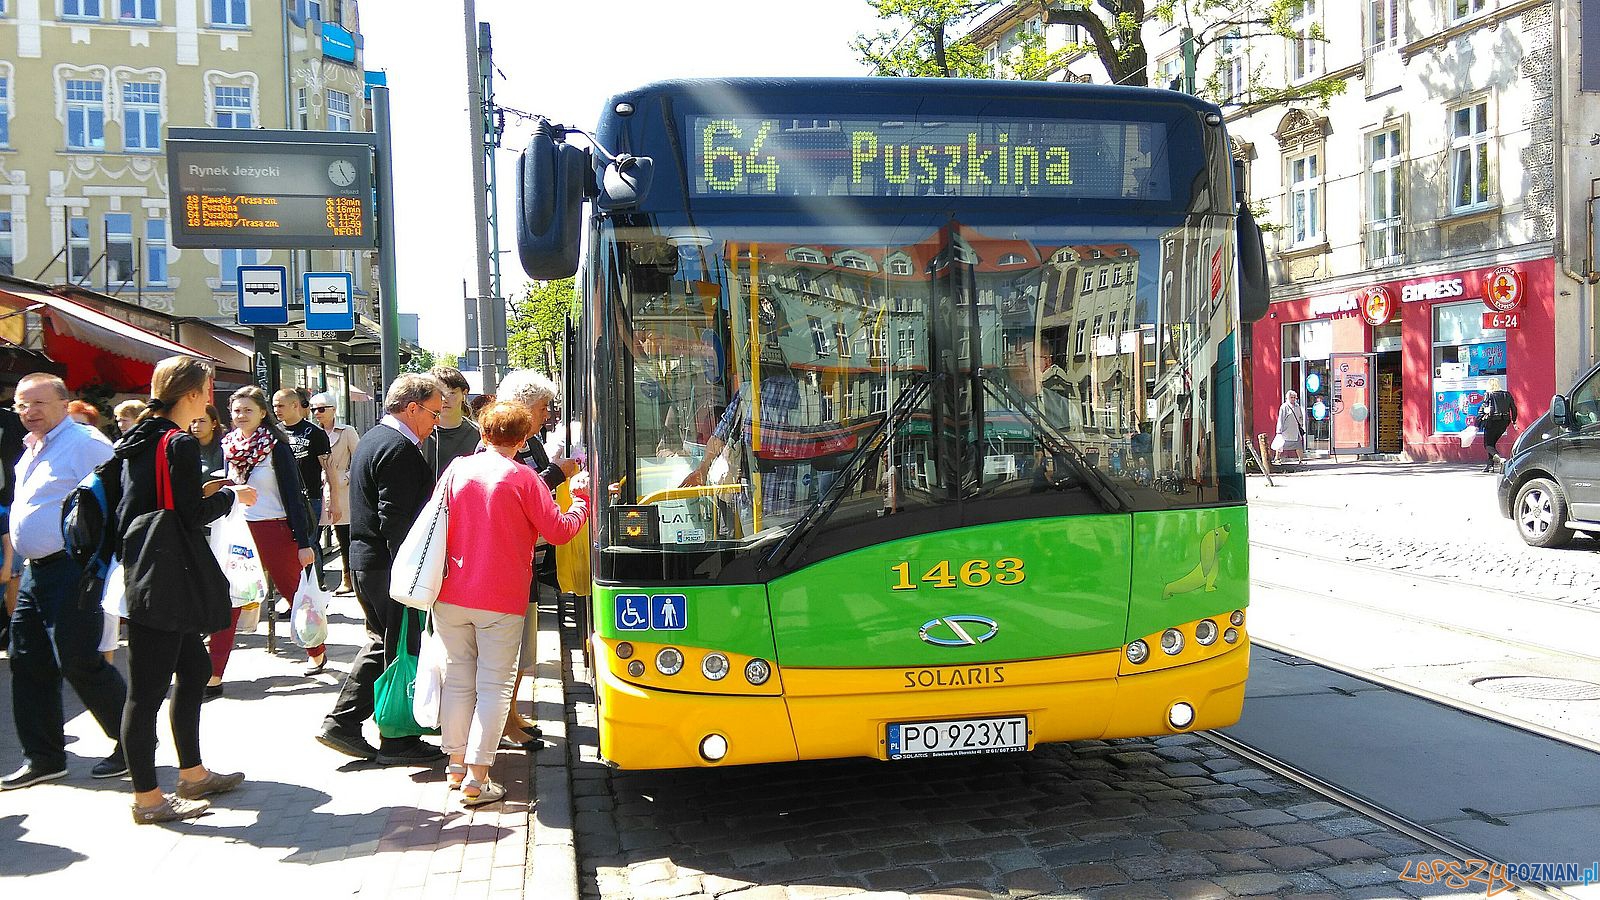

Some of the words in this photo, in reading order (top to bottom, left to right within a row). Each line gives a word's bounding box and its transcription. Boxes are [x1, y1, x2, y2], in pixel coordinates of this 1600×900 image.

[703, 120, 779, 191] 64
[852, 131, 1073, 185] Puszkina
[189, 165, 229, 177] Rynek
[232, 166, 280, 178] Jeżycki
[1493, 315, 1517, 327] 6-24
[891, 557, 1026, 590] 1463
[904, 667, 1005, 688] SOLARIS
[904, 726, 939, 750] PO
[949, 721, 1021, 748] 923XT
